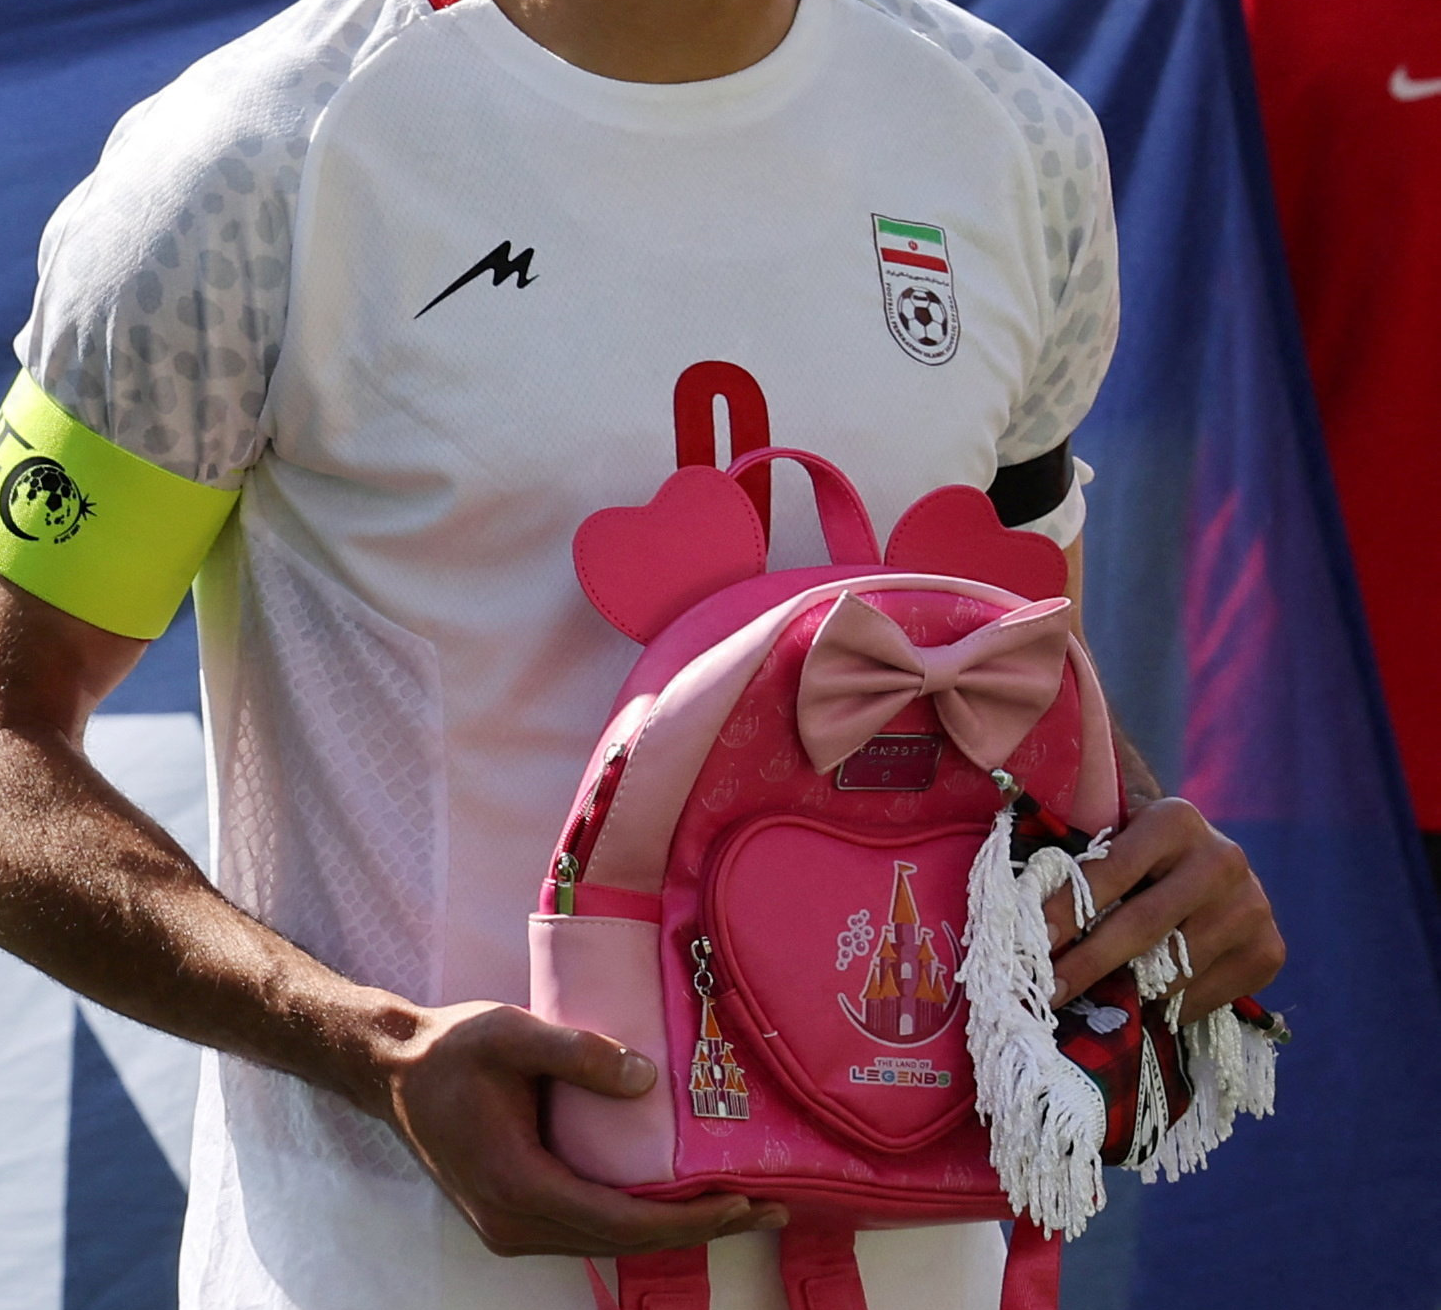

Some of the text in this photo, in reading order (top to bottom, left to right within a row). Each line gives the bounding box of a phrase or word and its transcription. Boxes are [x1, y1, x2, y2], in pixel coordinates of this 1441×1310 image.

[877, 1059, 930, 1069] THE LAND OF
[851, 1068, 950, 1087] LEGENDS
